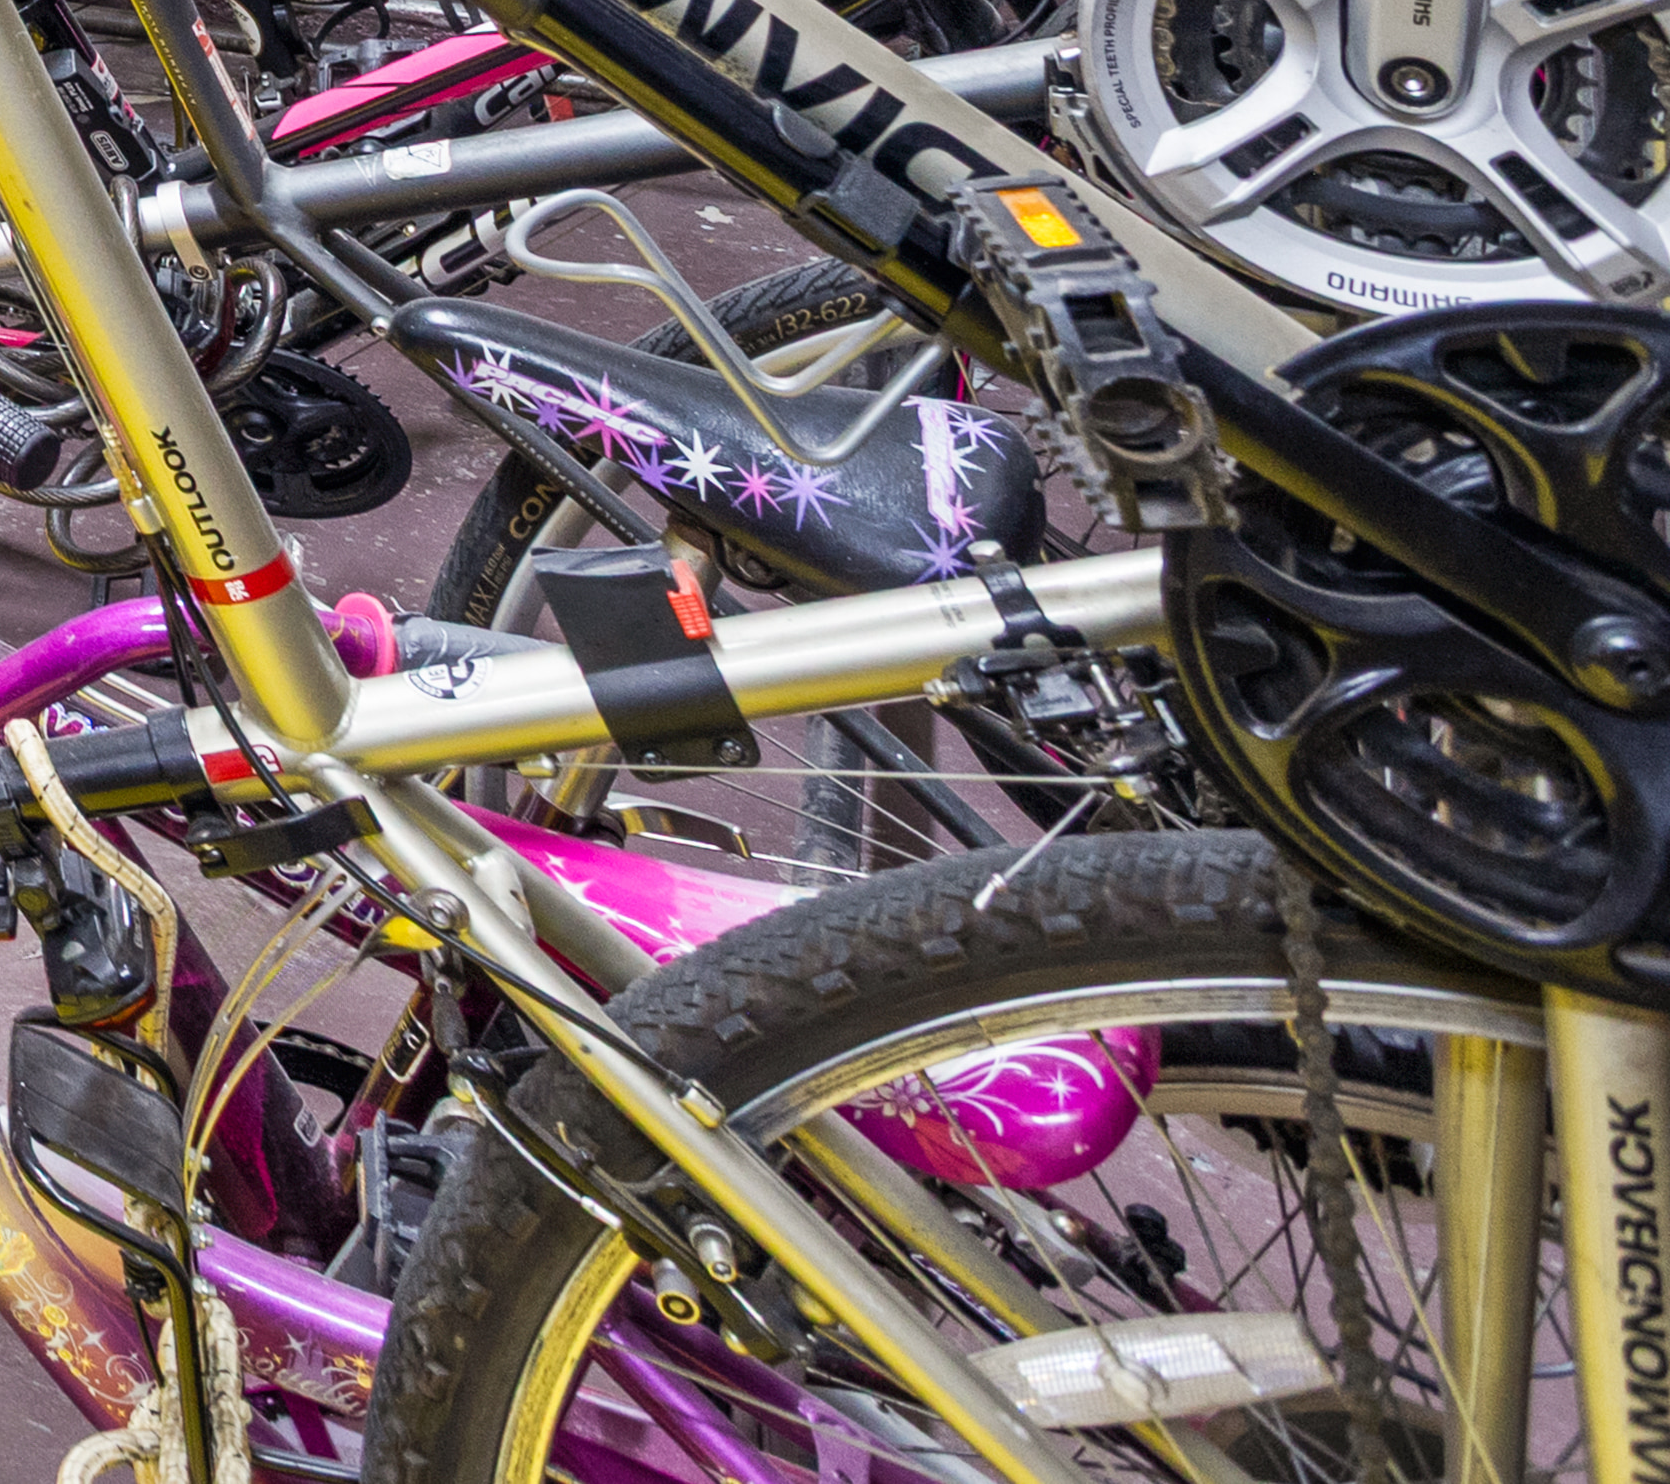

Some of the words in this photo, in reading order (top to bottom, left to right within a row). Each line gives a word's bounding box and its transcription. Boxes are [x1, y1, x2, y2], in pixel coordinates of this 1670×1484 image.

[1105, 39, 1122, 76] TEETH
[1114, 81, 1142, 129] SPECIAL
[96, 137, 125, 169] ABUS
[475, 360, 668, 446] PACIFIC
[153, 426, 237, 573] OUTLOOK
